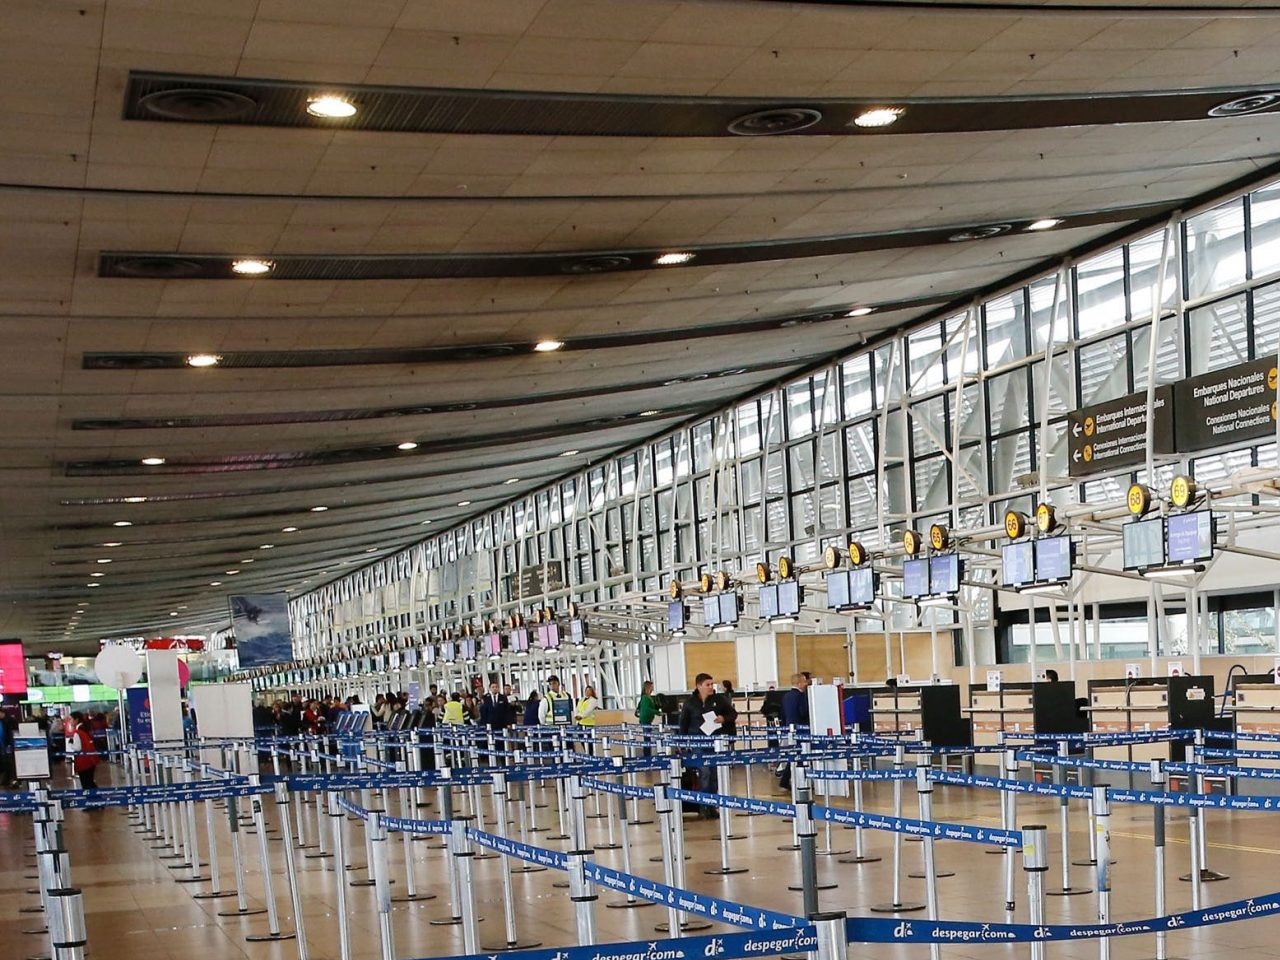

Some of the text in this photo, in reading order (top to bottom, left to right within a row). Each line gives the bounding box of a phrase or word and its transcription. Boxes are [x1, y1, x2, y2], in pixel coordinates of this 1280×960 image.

[1194, 372, 1264, 398] Embarques Nacionales
[1204, 384, 1264, 407] National Departures
[1096, 410, 1123, 423] Embarques
[1238, 403, 1270, 418] Nacionales
[1213, 415, 1270, 435] National Connections
[1174, 484, 1185, 498] 69
[1131, 492, 1140, 506] 68
